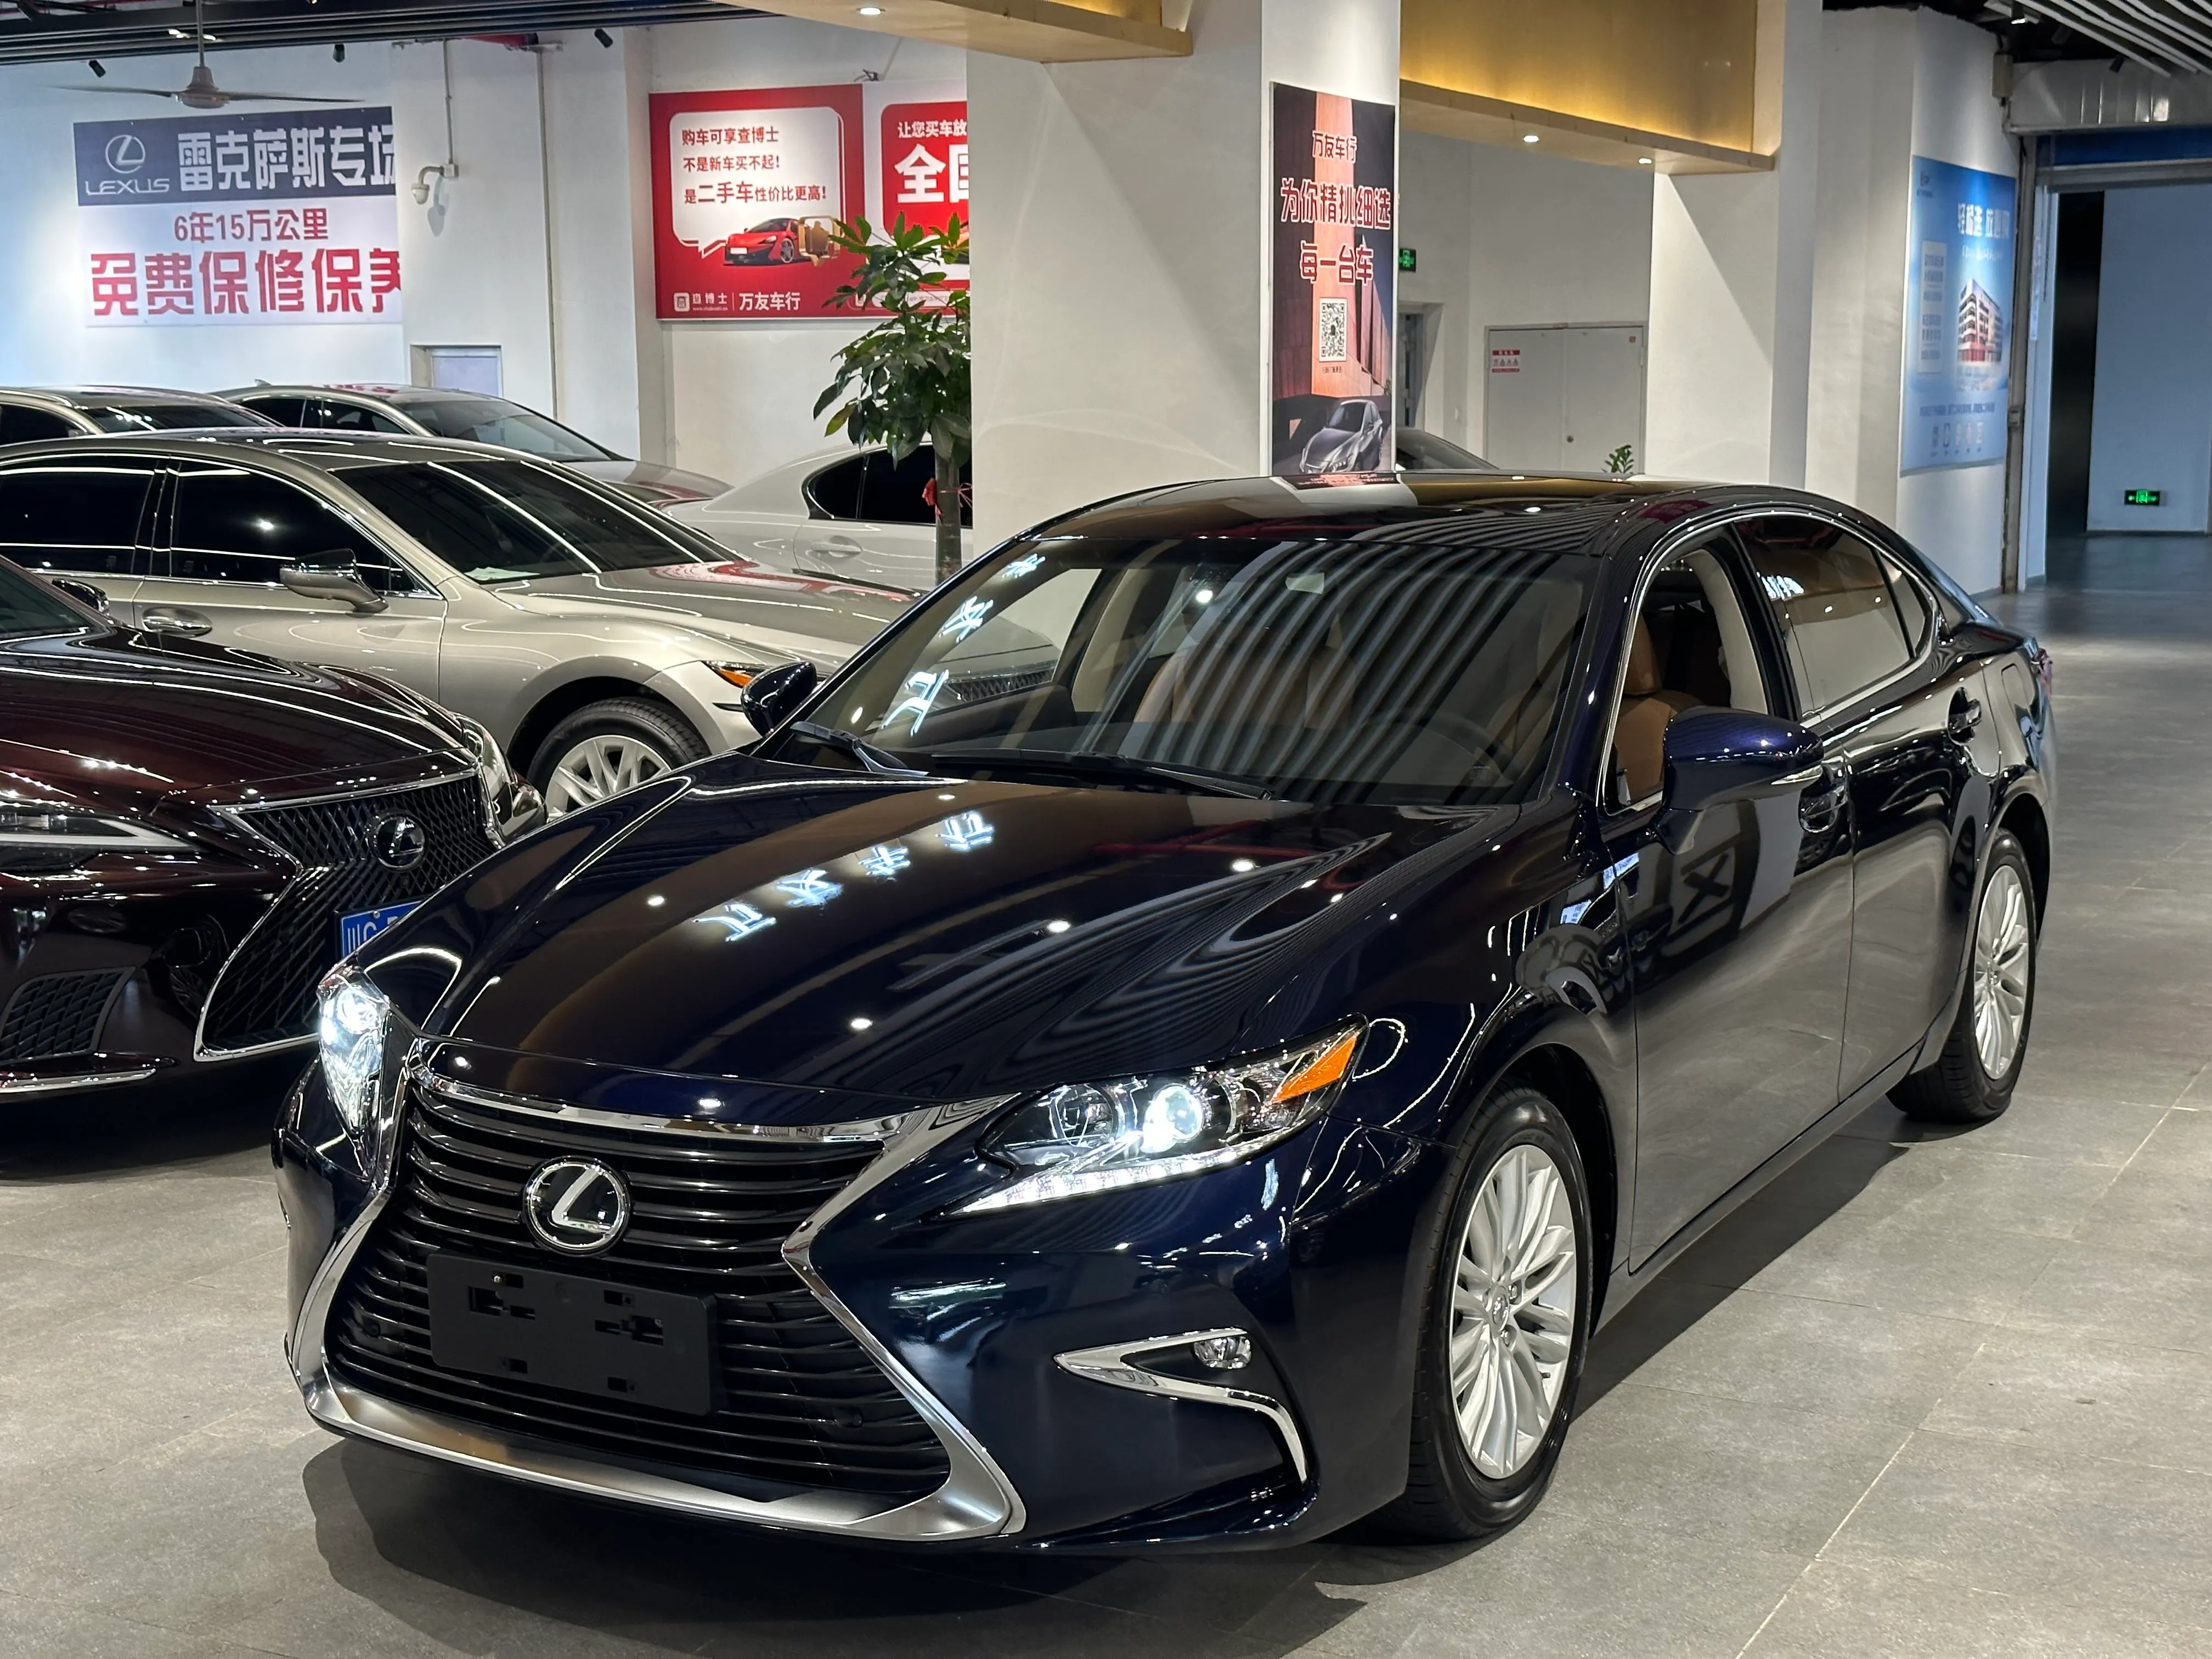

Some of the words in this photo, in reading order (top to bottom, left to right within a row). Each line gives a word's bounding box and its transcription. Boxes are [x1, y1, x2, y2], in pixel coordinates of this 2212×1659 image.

[682, 126, 779, 146] 购车可享查博士
[1312, 130, 1358, 163] 万友车行
[683, 155, 780, 172] 不是新车买不起!
[85, 178, 170, 195] LEXUS
[684, 180, 826, 204] 是二手车性价比更高!
[1280, 177, 1391, 230] 为你精挑细选
[174, 208, 329, 242] 6年15万公里
[1300, 240, 1374, 286] 每一台车
[739, 291, 800, 311] 万友车行
